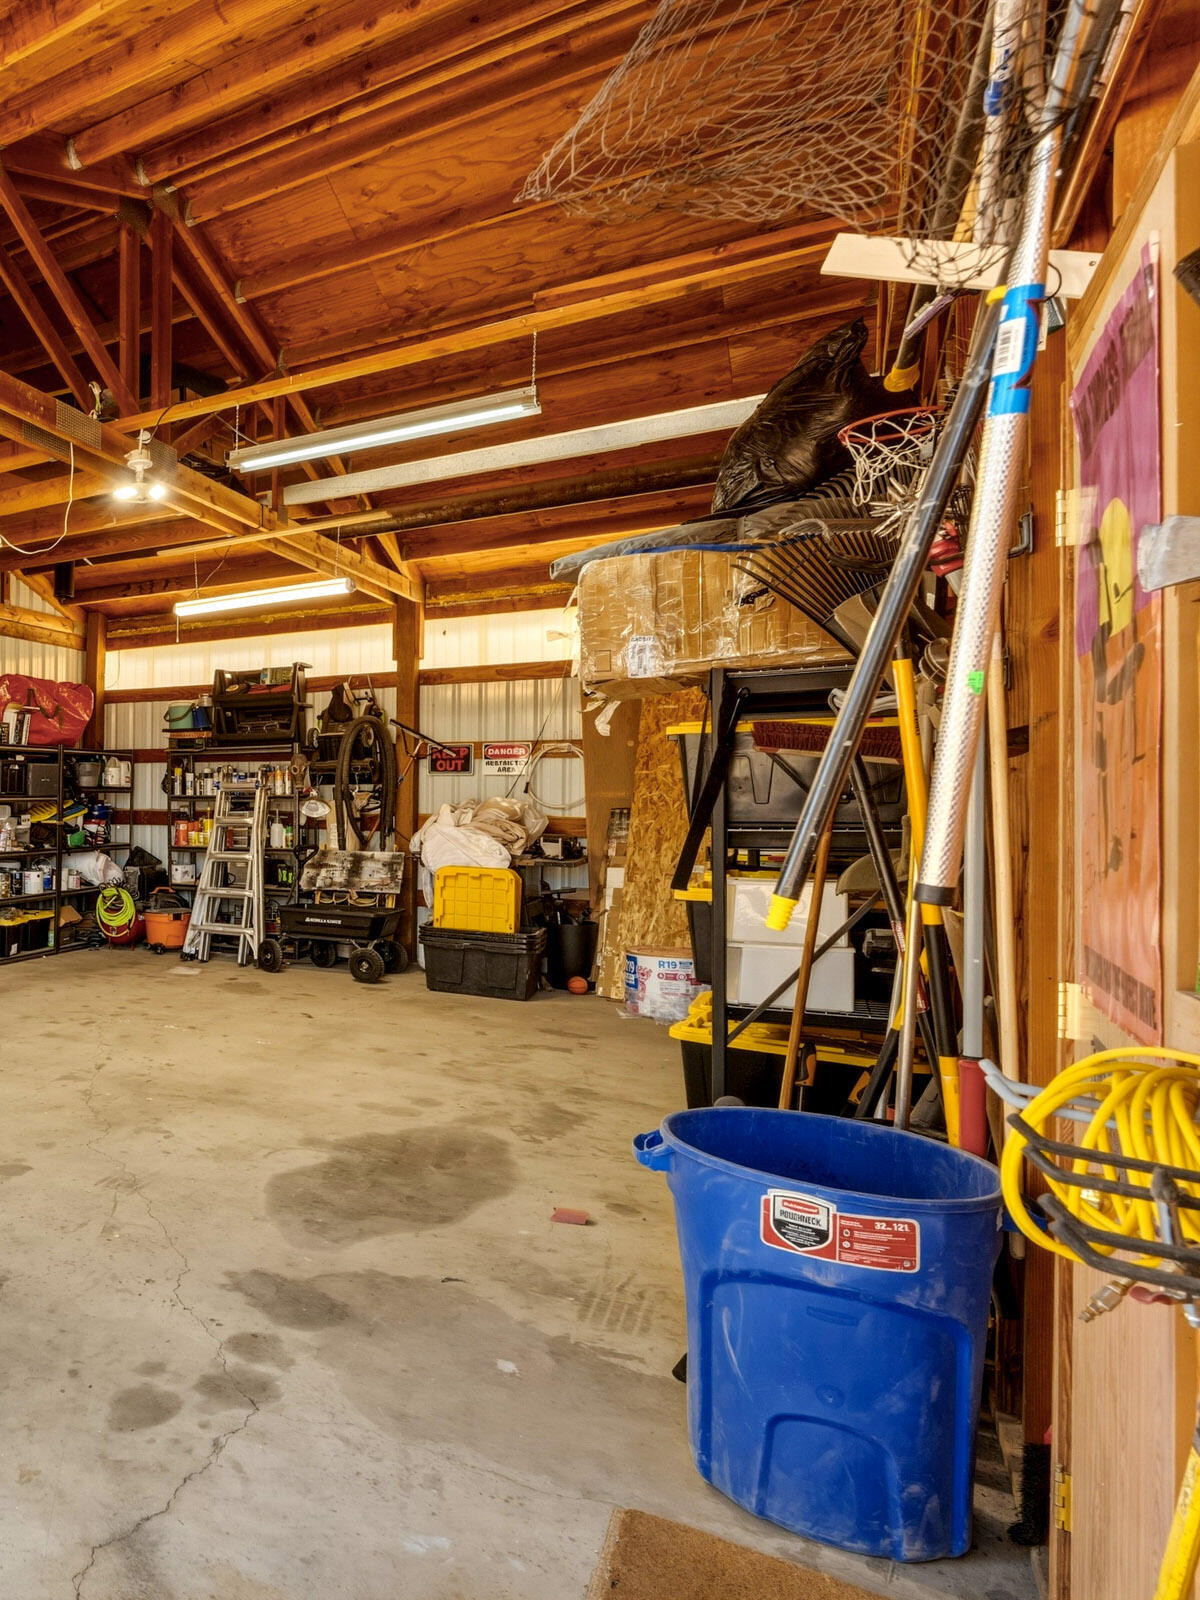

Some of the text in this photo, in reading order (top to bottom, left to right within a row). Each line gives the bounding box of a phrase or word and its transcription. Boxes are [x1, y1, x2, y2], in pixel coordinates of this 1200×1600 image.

[487, 747, 526, 755] DANGER
[435, 760, 465, 771] OUT
[658, 960, 678, 969] R19
[780, 1209, 822, 1227] ROUGHNECK
[874, 1221, 887, 1230] 32
